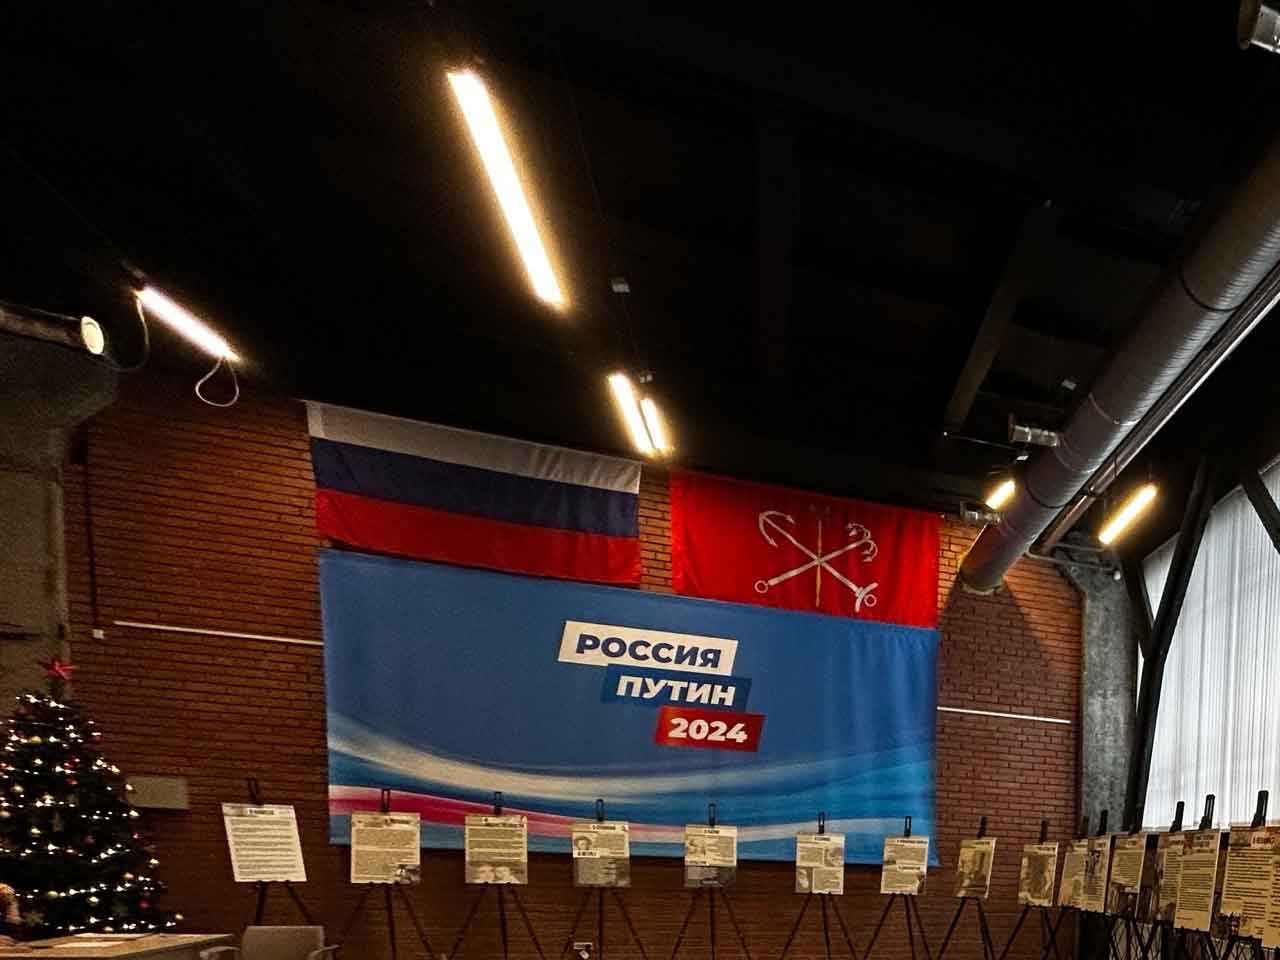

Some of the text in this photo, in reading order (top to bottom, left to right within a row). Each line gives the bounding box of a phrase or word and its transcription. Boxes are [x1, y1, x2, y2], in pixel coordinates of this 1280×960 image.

[575, 633, 722, 669] РОССИЯ
[616, 675, 736, 707] ПУТИН
[667, 717, 748, 743] 2024
